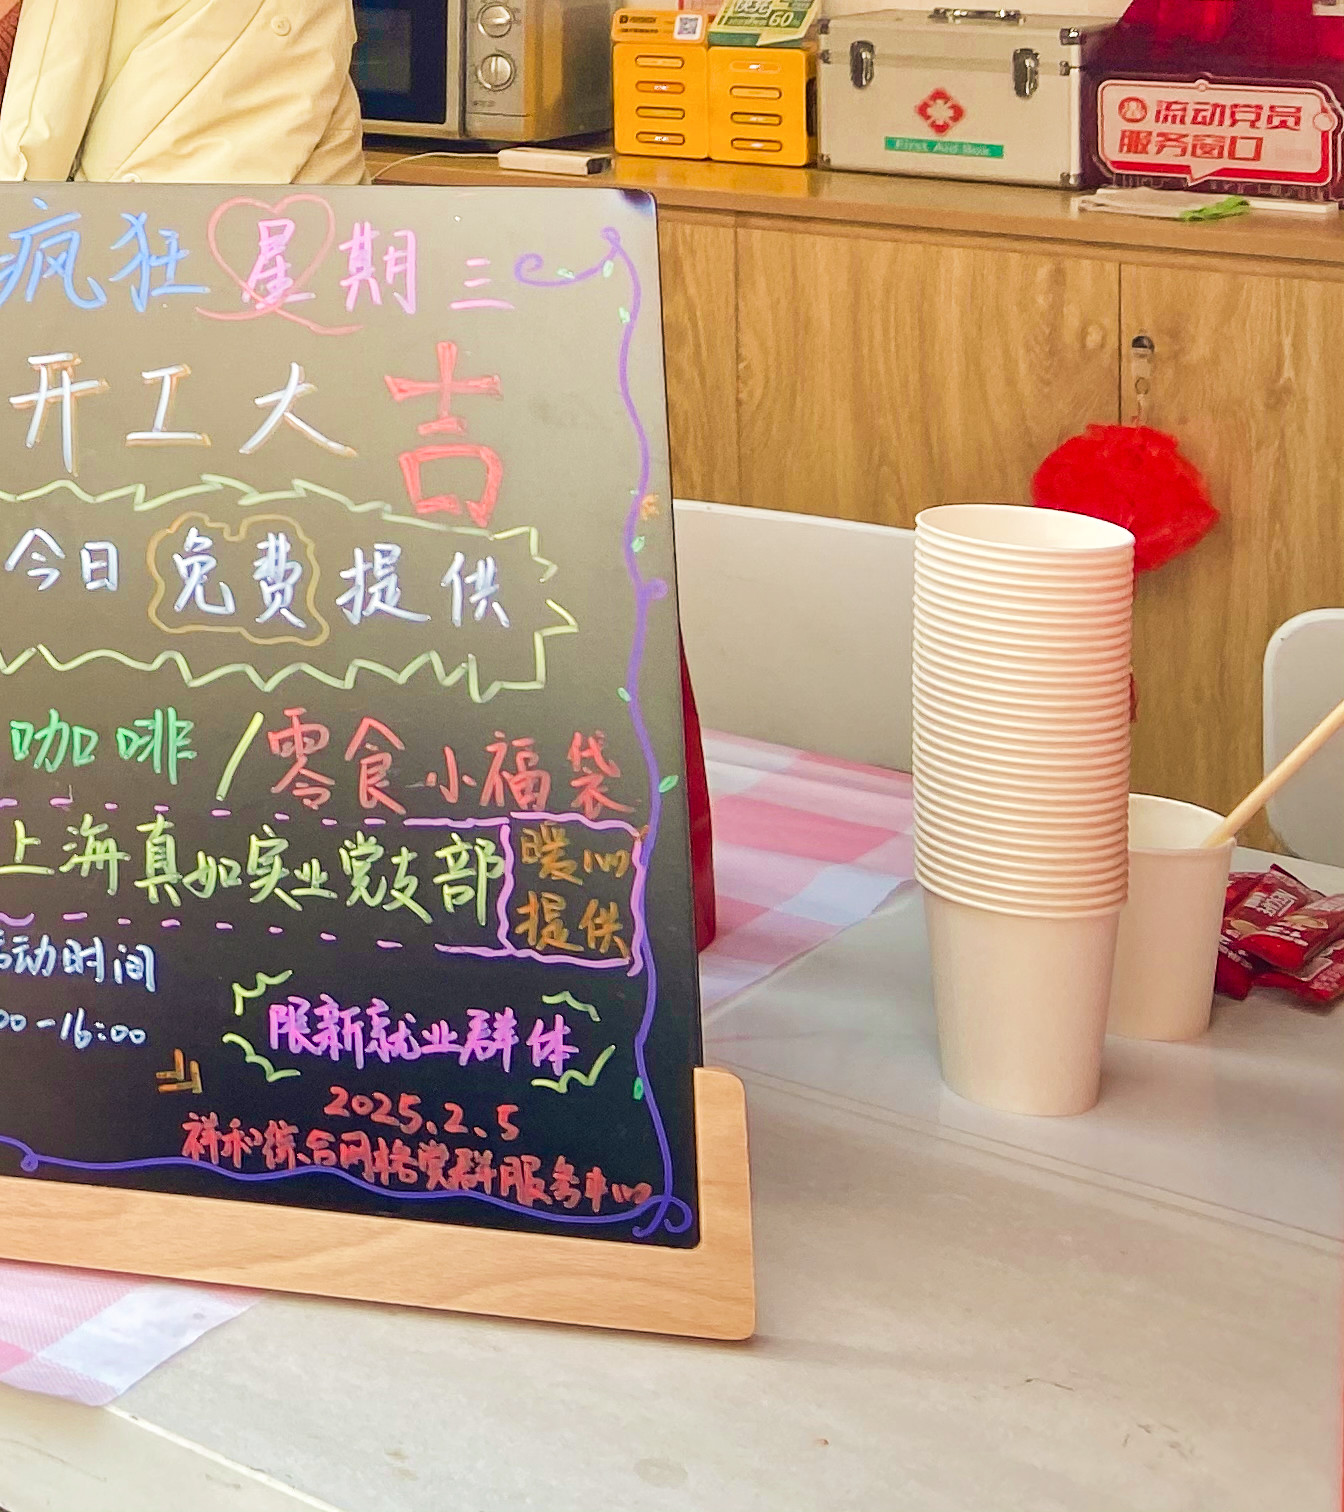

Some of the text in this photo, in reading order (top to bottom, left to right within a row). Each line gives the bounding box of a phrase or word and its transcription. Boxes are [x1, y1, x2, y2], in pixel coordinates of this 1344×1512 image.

[768, 11, 794, 26] 60
[1118, 129, 1264, 161] 服务窗口
[1155, 100, 1302, 131] 流动党员
[9, 340, 502, 527] 开工大吉
[5, 527, 510, 629] 今日免费提供
[515, 891, 630, 958] 提供
[269, 995, 579, 1075] 限新就业群体
